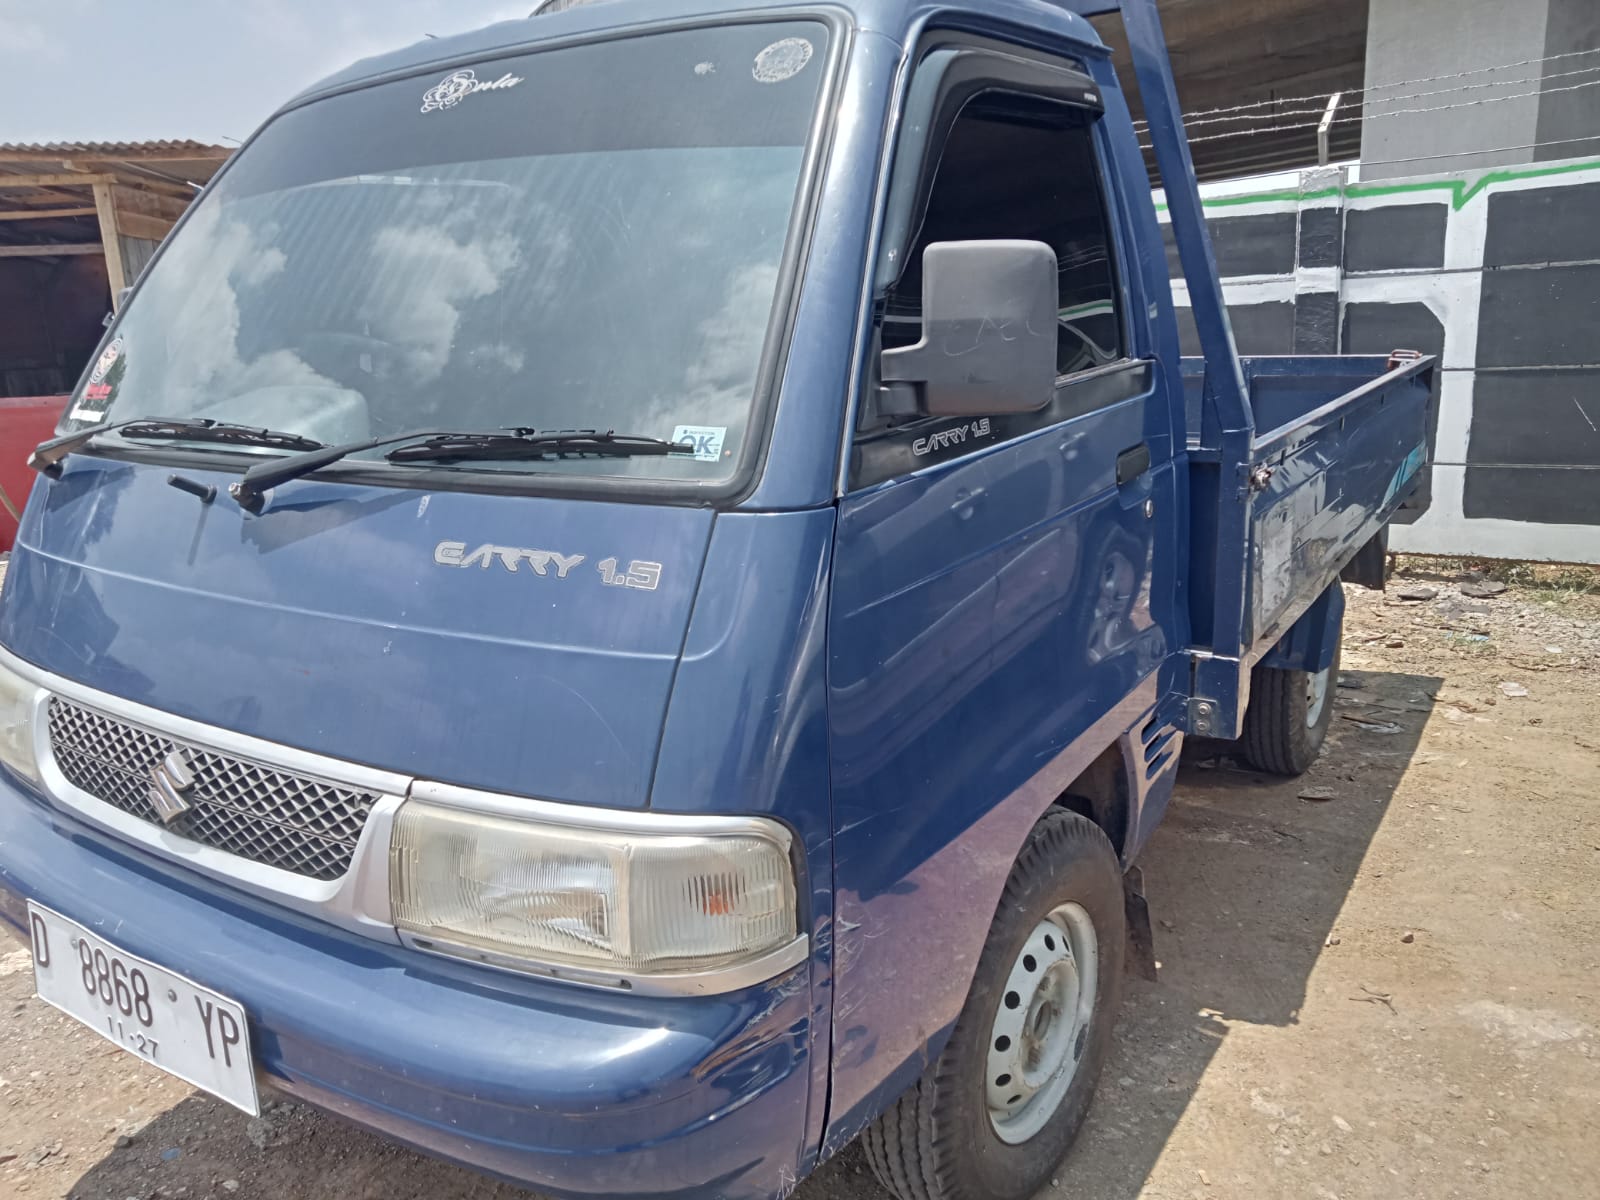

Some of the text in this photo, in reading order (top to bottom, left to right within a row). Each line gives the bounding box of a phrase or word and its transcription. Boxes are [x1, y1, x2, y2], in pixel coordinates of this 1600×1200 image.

[912, 417, 990, 456] CARRY 1.5
[434, 541, 662, 590] CARRY 1.5
[31, 911, 240, 1068] D 8868 YP
